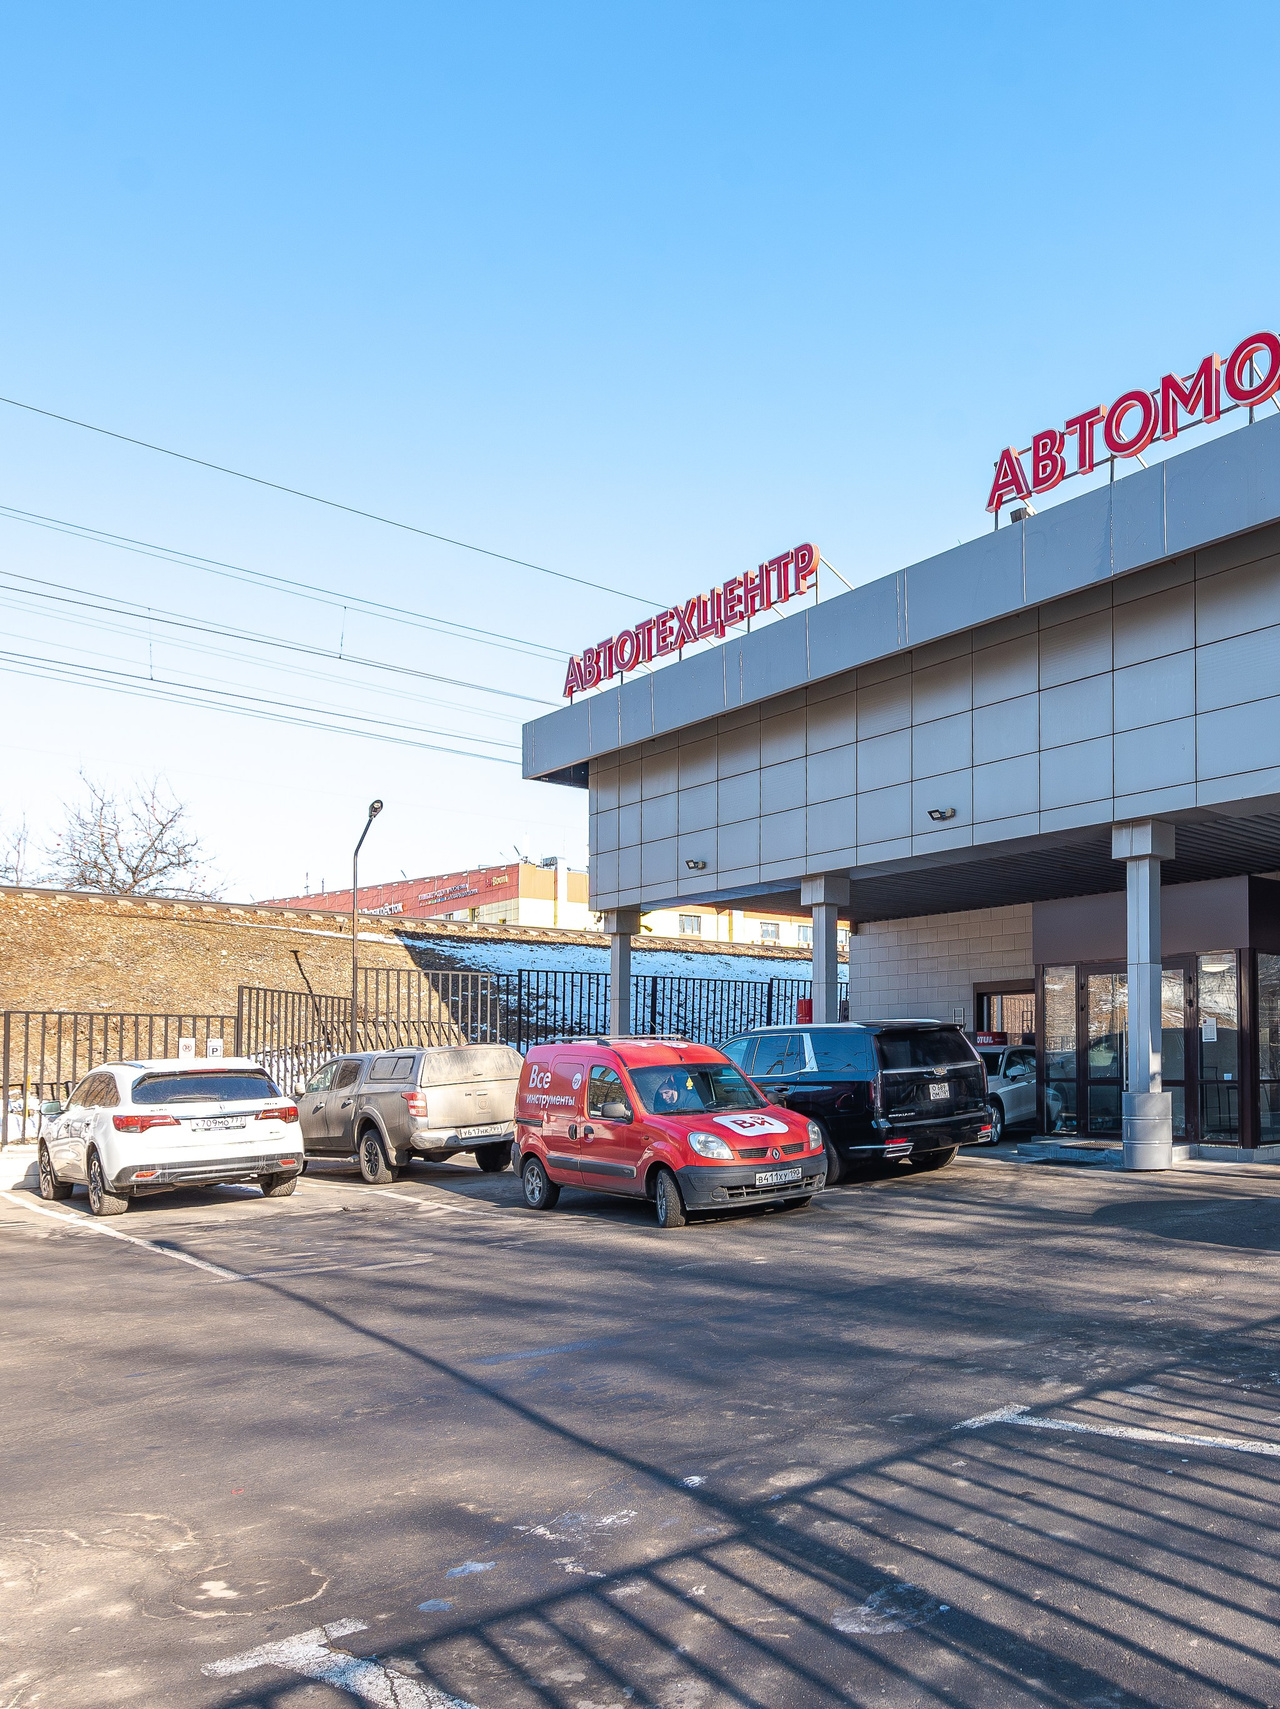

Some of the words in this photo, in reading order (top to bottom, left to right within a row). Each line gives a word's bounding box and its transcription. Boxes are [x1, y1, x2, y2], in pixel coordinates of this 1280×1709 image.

[563, 541, 820, 698] АВТОТЕХЦЕНТР
[528, 1064, 552, 1089] Все
[526, 1094, 576, 1109] инструменты
